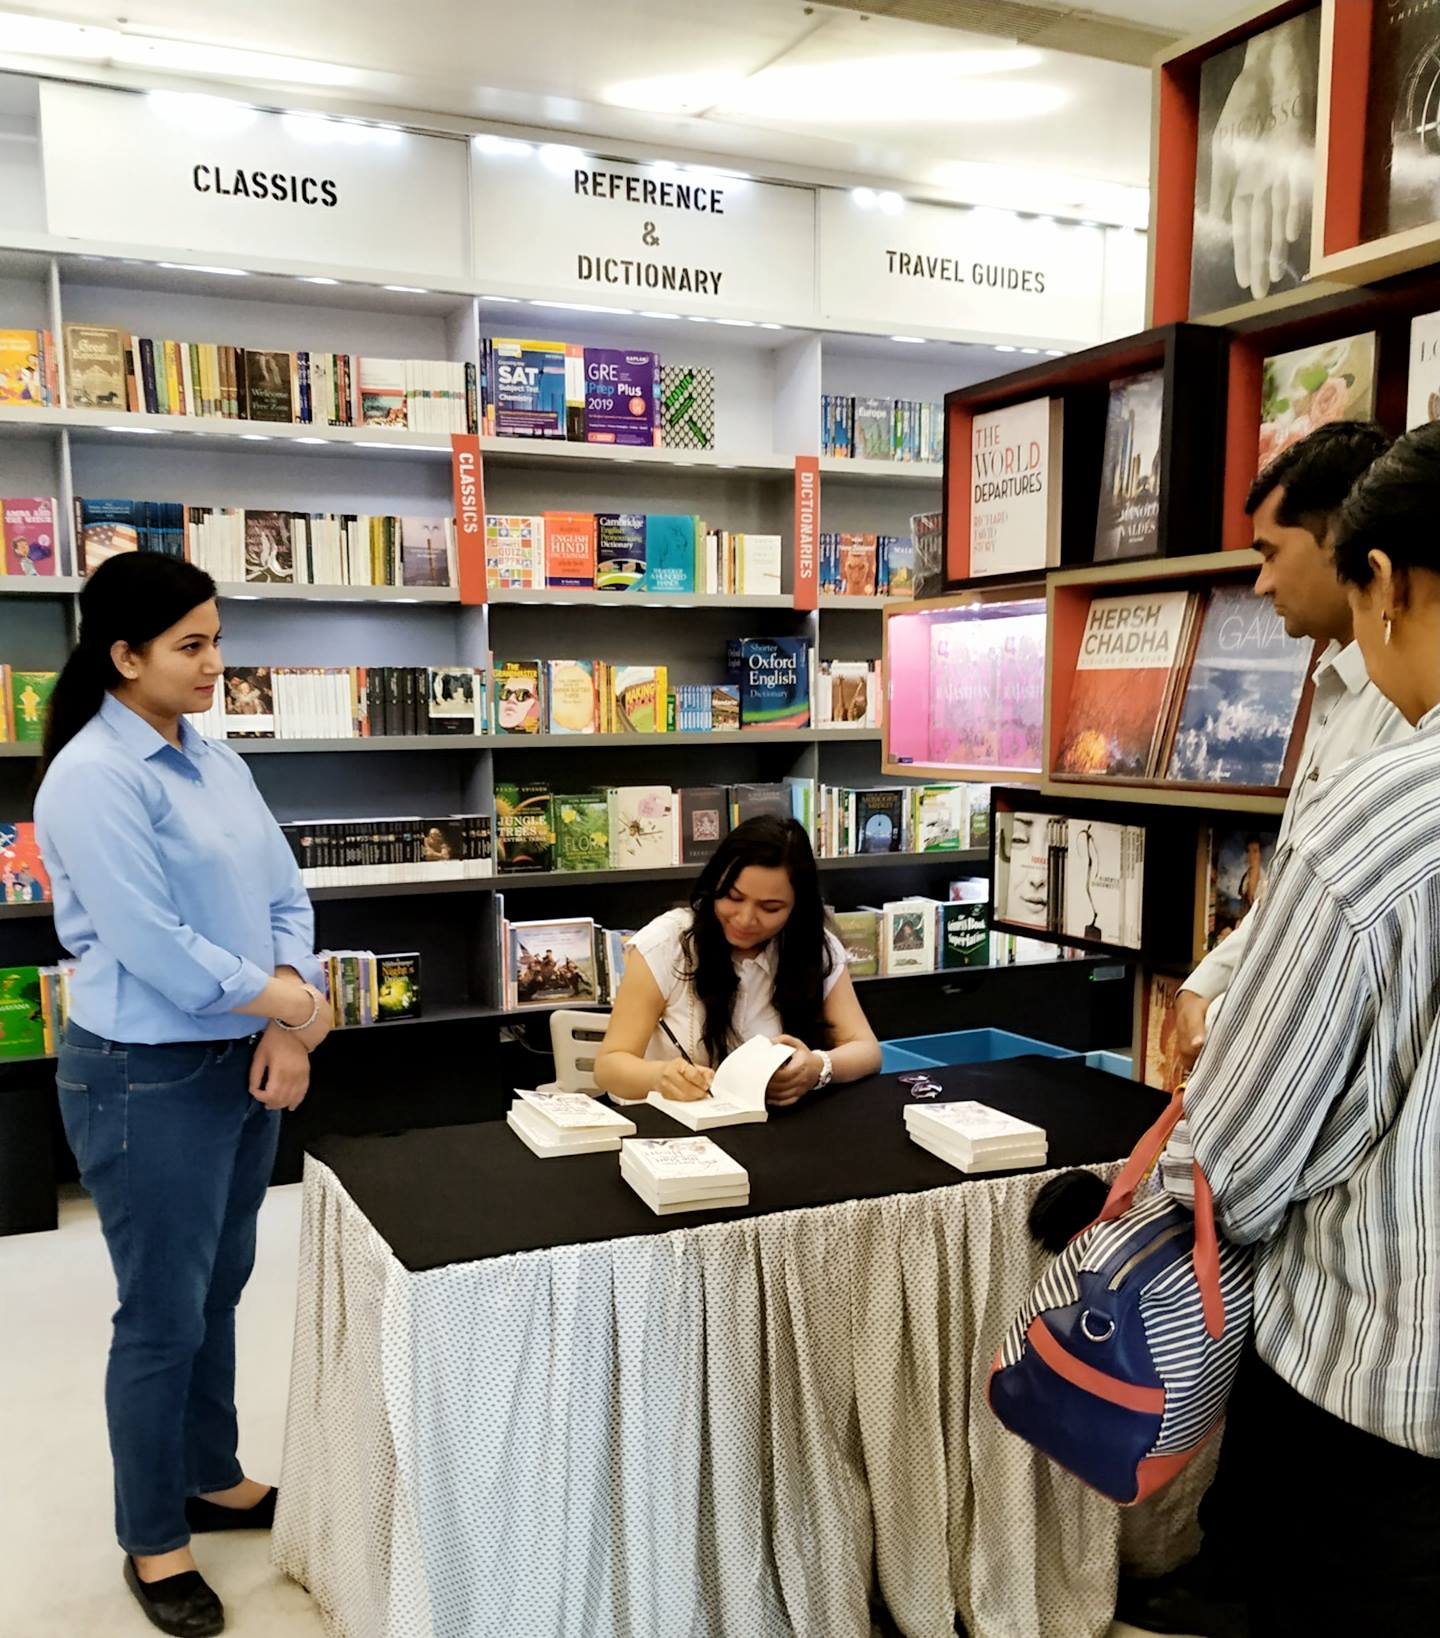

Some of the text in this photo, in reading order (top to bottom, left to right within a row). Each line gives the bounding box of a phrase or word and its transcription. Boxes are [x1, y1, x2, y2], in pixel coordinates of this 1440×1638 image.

[193, 164, 338, 207] CLASSICS
[574, 169, 725, 214] REFERENCE
[641, 221, 660, 247] &
[577, 255, 723, 295] DICTIONARY
[886, 250, 1046, 294] TRAVEL GUIDES
[498, 366, 539, 386] SAT
[588, 363, 619, 381] GRE
[589, 382, 642, 396] Prep Plus
[588, 398, 614, 410] 2019
[858, 406, 888, 420] Europe
[976, 424, 1000, 449] THE
[974, 441, 1041, 479] WORLD
[459, 452, 478, 533] CLASSICS
[974, 472, 1043, 504] DEPARTURES
[600, 514, 644, 529] Cambridge
[801, 472, 814, 579] DICTIONARIES
[551, 534, 589, 544] ENGLISH
[551, 542, 589, 553] HINDI
[601, 540, 634, 551] Dictionary
[1089, 603, 1162, 631] HERSH
[1218, 614, 1286, 651] GAIA
[749, 643, 778, 653] Shorter
[1084, 630, 1169, 655] CHADHA
[748, 652, 797, 670] Oxford
[749, 670, 797, 689] English
[750, 689, 788, 699] Dictionary
[498, 815, 546, 827] JUNGLE
[498, 827, 537, 837] TREES
